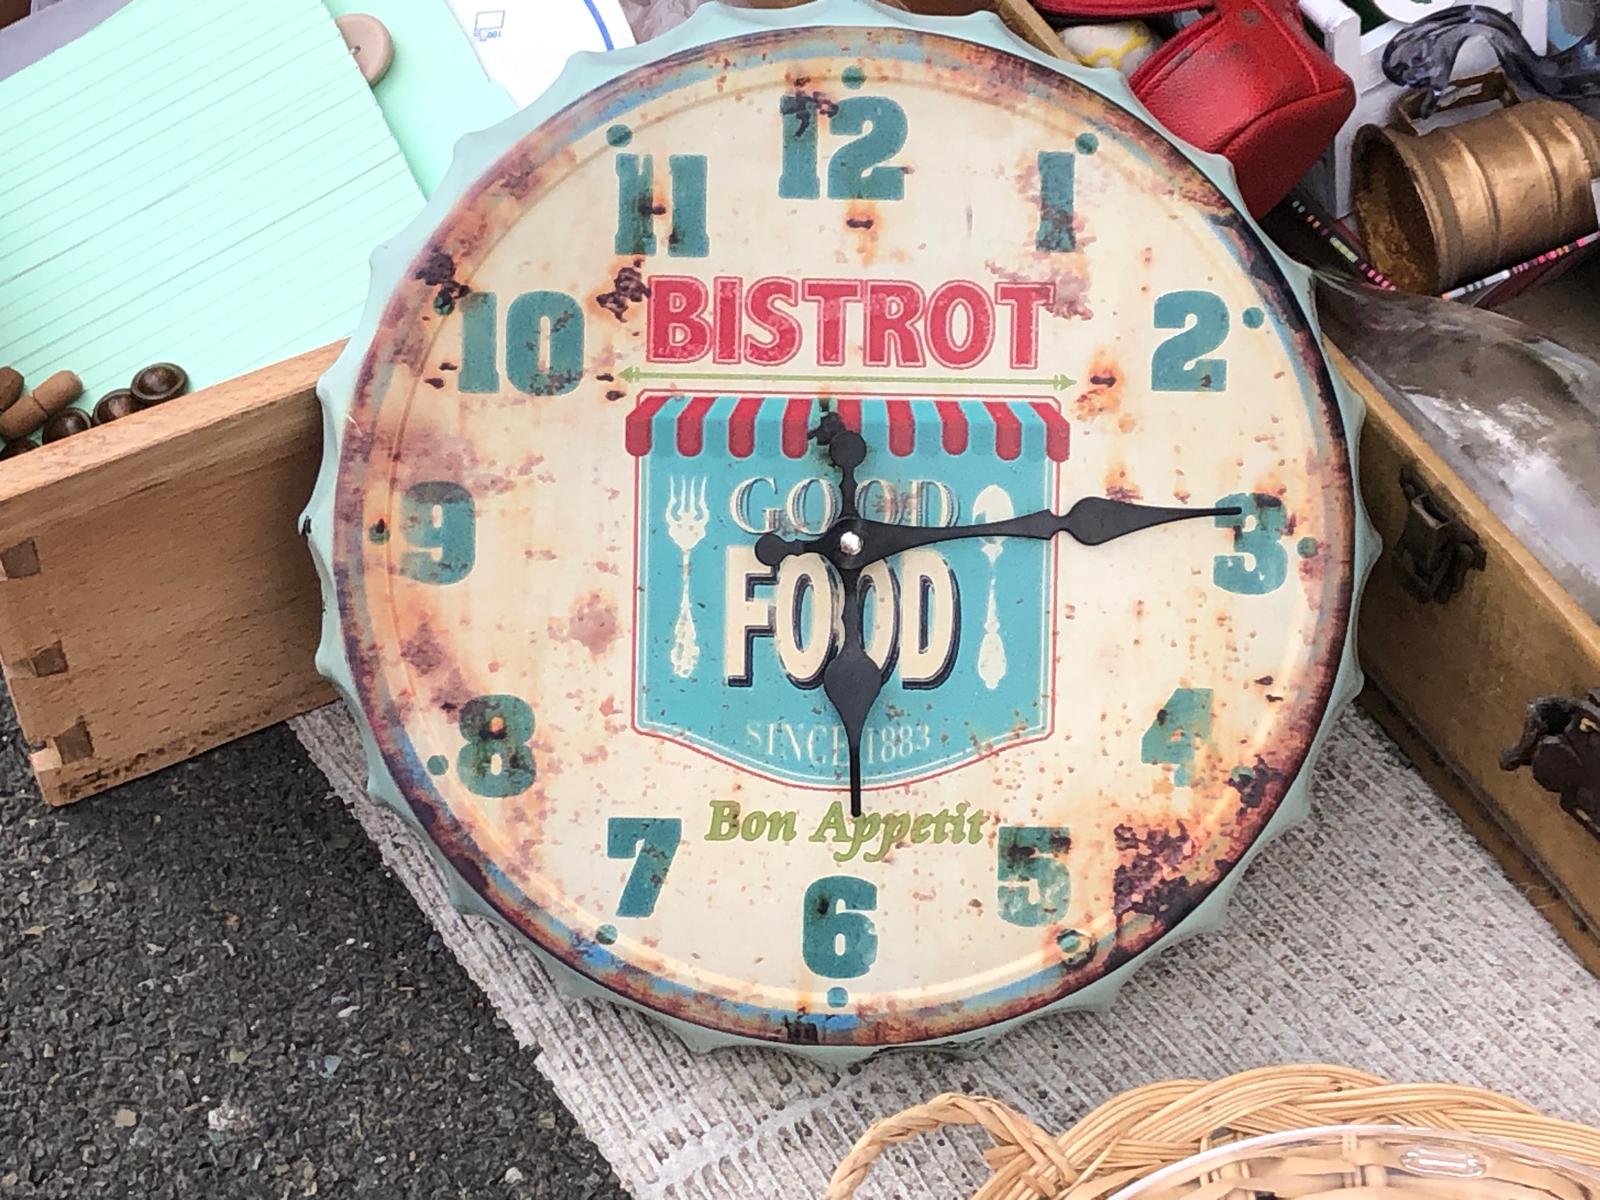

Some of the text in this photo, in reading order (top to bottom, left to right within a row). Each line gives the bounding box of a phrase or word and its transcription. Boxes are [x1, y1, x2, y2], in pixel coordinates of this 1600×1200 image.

[778, 95, 906, 201] 12
[614, 153, 710, 258] 11
[1036, 151, 1076, 252] 1
[458, 290, 585, 396] 10
[646, 274, 1057, 371] BISTROT
[1151, 290, 1230, 392] 2
[400, 480, 476, 586] 9
[729, 476, 961, 535] GOOD
[1213, 492, 1288, 595] 3
[724, 545, 962, 690] FOOD
[457, 694, 537, 798] 8
[745, 721, 931, 768] SINCE 1883
[1141, 687, 1214, 788] 4
[607, 817, 682, 917] 7
[703, 800, 990, 863] Bon Appetit
[997, 826, 1071, 928] 5
[803, 875, 878, 979] 6
